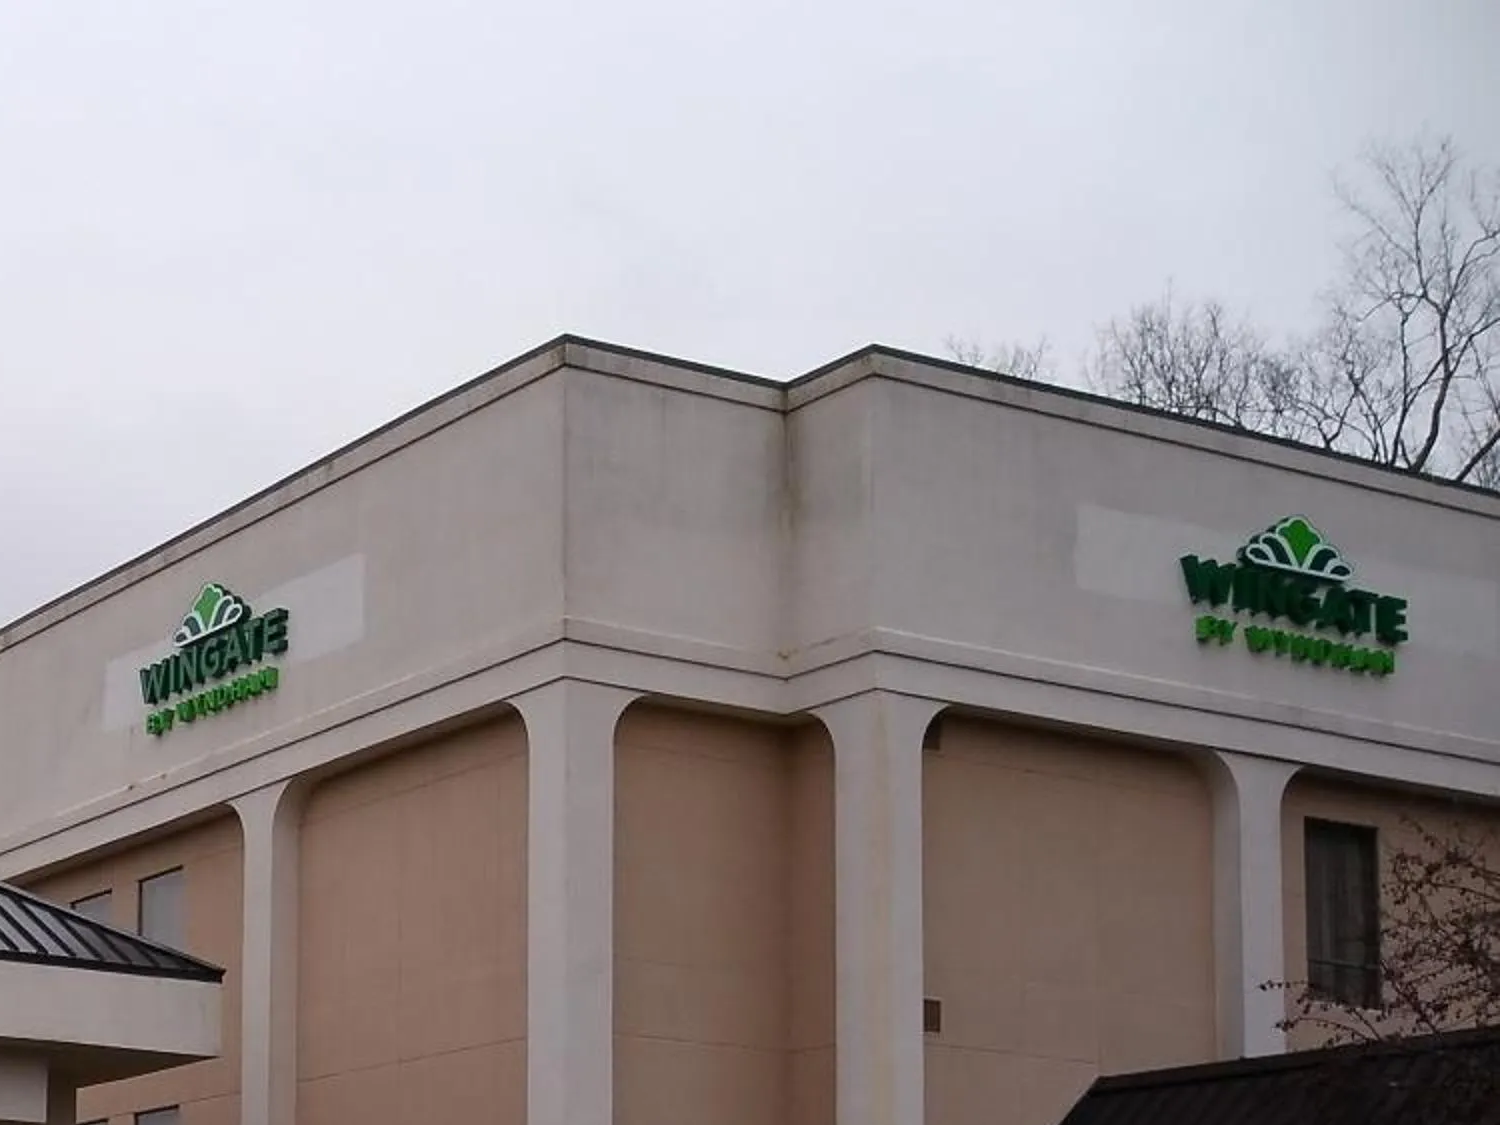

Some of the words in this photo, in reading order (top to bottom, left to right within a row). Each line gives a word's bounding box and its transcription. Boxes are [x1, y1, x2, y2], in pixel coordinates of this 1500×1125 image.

[1180, 554, 1408, 645] WINGATE
[139, 607, 288, 705] WINGATE
[146, 708, 175, 735] BY
